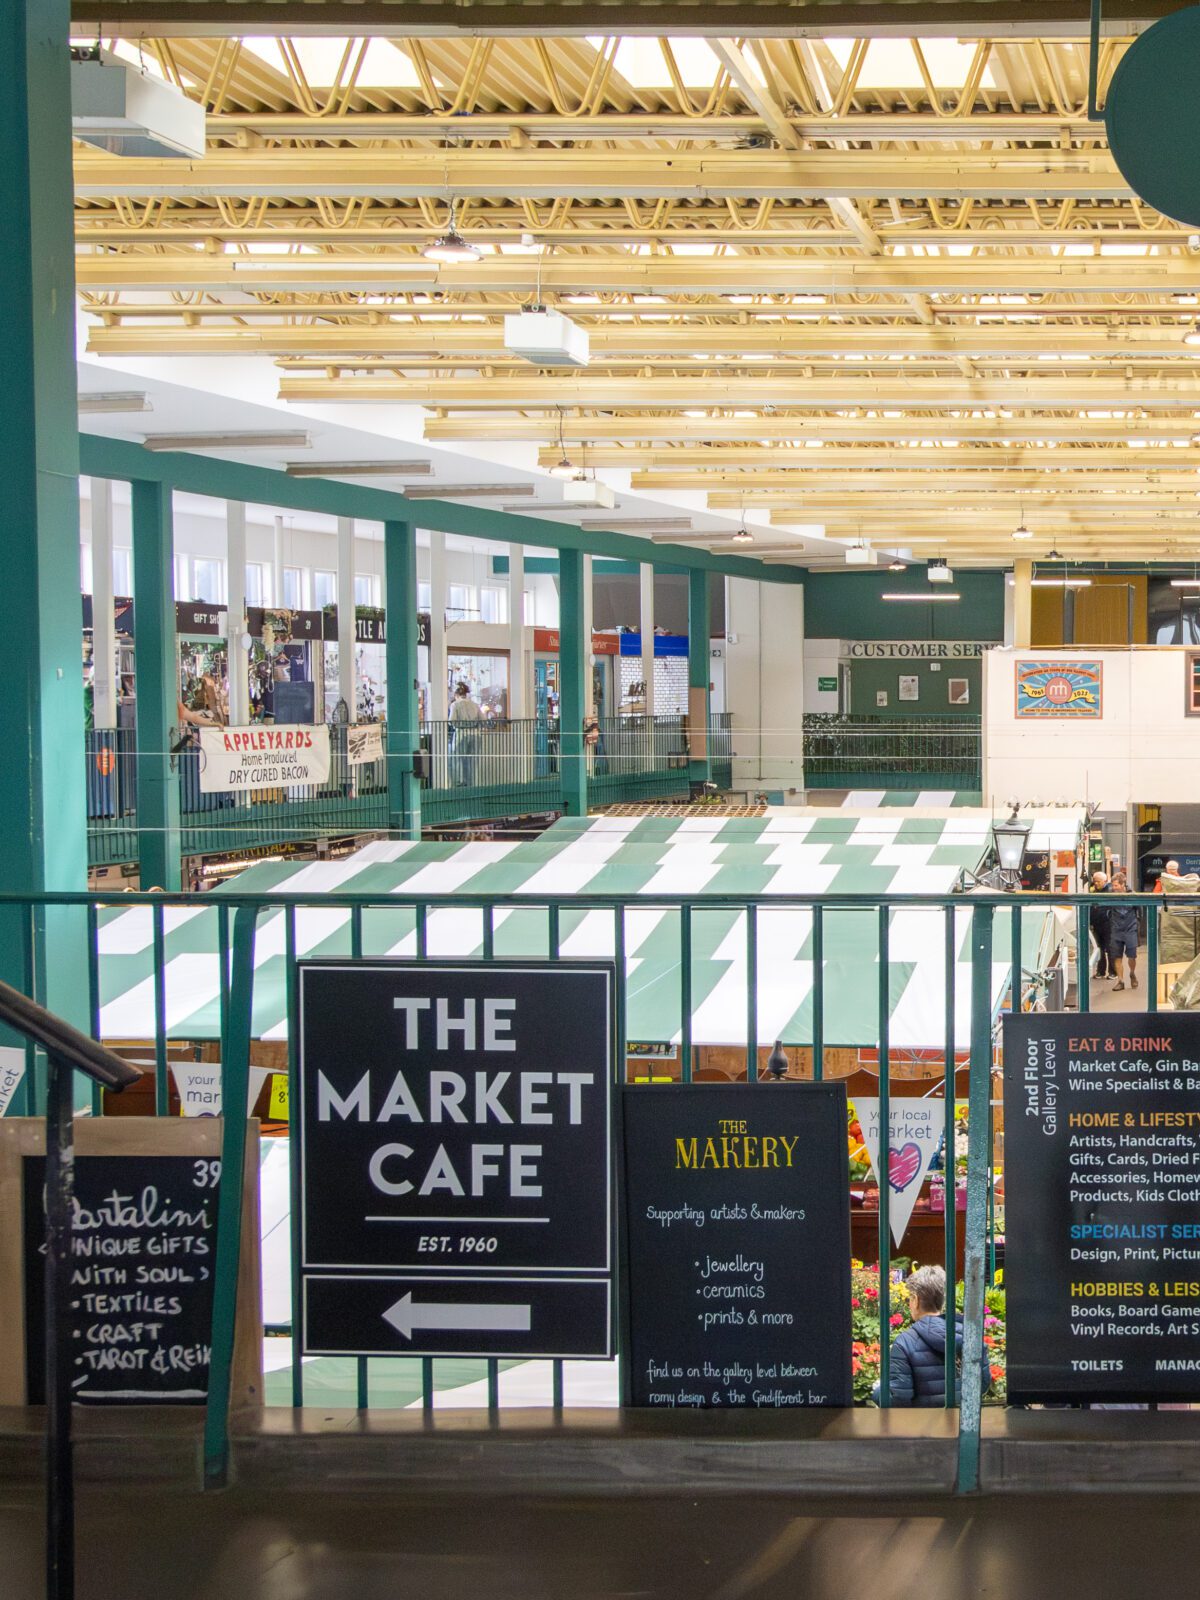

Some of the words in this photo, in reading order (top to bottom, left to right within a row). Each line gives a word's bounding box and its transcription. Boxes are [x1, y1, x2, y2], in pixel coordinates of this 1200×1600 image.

[194, 613, 207, 624] GIFT
[852, 643, 948, 657] CUSTOMER
[223, 731, 313, 751] APPLEYARDS
[241, 754, 262, 766] Home
[264, 751, 297, 765] Produced
[229, 769, 252, 784] DRY
[251, 767, 278, 783] CURED
[281, 765, 308, 780] BACON
[394, 997, 516, 1051] THE
[1069, 1038, 1100, 1052] EAT
[1104, 1038, 1115, 1052] &
[1121, 1037, 1173, 1051] DRINK
[1024, 1038, 1039, 1081] Floor
[1042, 1039, 1057, 1078] Level
[1069, 1060, 1116, 1073] Market
[1120, 1060, 1152, 1073] Cafe,
[1155, 1060, 1179, 1072] Gin
[188, 1075, 215, 1086] your
[1069, 1079, 1103, 1091] Wine
[1106, 1078, 1169, 1093] Specialist
[1173, 1079, 1184, 1090] &
[318, 1069, 594, 1125] MARKET
[1024, 1085, 1039, 1117] 2nd
[902, 1109, 931, 1120] local
[1042, 1082, 1059, 1136] Gallery
[719, 1119, 747, 1134] THE
[1069, 1113, 1119, 1126] HOME
[1124, 1113, 1135, 1126] &
[1069, 1135, 1116, 1148] Artists,
[1120, 1134, 1196, 1147] Handcrafts,
[675, 1136, 799, 1169] MAKERY
[1069, 1153, 1104, 1166] Gifts,
[1107, 1154, 1148, 1166] Cards,
[1152, 1153, 1189, 1165] Dried
[192, 1160, 221, 1188] 39
[369, 1142, 543, 1197] CAFE
[1070, 1172, 1150, 1185] Accessories,
[1070, 1190, 1132, 1203] Products,
[1136, 1190, 1164, 1201] Kids
[646, 1202, 705, 1228] Supporting
[710, 1204, 748, 1220] artists
[751, 1204, 764, 1219] &
[764, 1204, 805, 1220] makers
[1070, 1224, 1168, 1239] SPECIALIST
[147, 1232, 209, 1255] GIFTS
[418, 1236, 453, 1253] EST.
[459, 1237, 498, 1253] 1960
[1070, 1248, 1120, 1262] Design,
[1124, 1248, 1159, 1261] Print,
[135, 1266, 195, 1283] SOUL
[701, 1254, 764, 1281] jewellery
[703, 1284, 765, 1299] ceramics
[1071, 1283, 1144, 1297] HOBBIES
[1148, 1283, 1160, 1296] &
[82, 1291, 182, 1314] TEXTILES
[1071, 1304, 1115, 1318] Books,
[1118, 1304, 1158, 1317] Board
[704, 1306, 744, 1331] prints
[747, 1309, 759, 1325] &
[762, 1312, 794, 1325] more
[86, 1323, 162, 1344] CRAFT
[1071, 1323, 1104, 1338] Vinyl
[1107, 1323, 1164, 1336] Records,
[1167, 1323, 1188, 1335] Art
[82, 1348, 150, 1371] TAROT
[1071, 1360, 1123, 1371] TOILETS
[647, 1358, 669, 1383] find
[672, 1367, 683, 1377] us
[687, 1367, 700, 1377] on
[704, 1362, 721, 1377] the
[723, 1361, 752, 1385] gallery
[757, 1362, 777, 1377] level
[781, 1362, 818, 1377] between
[678, 1389, 705, 1407] design
[712, 1392, 722, 1403] &
[727, 1389, 746, 1403] the
[752, 1389, 803, 1407] Gindifferent
[809, 1390, 827, 1404] bar
